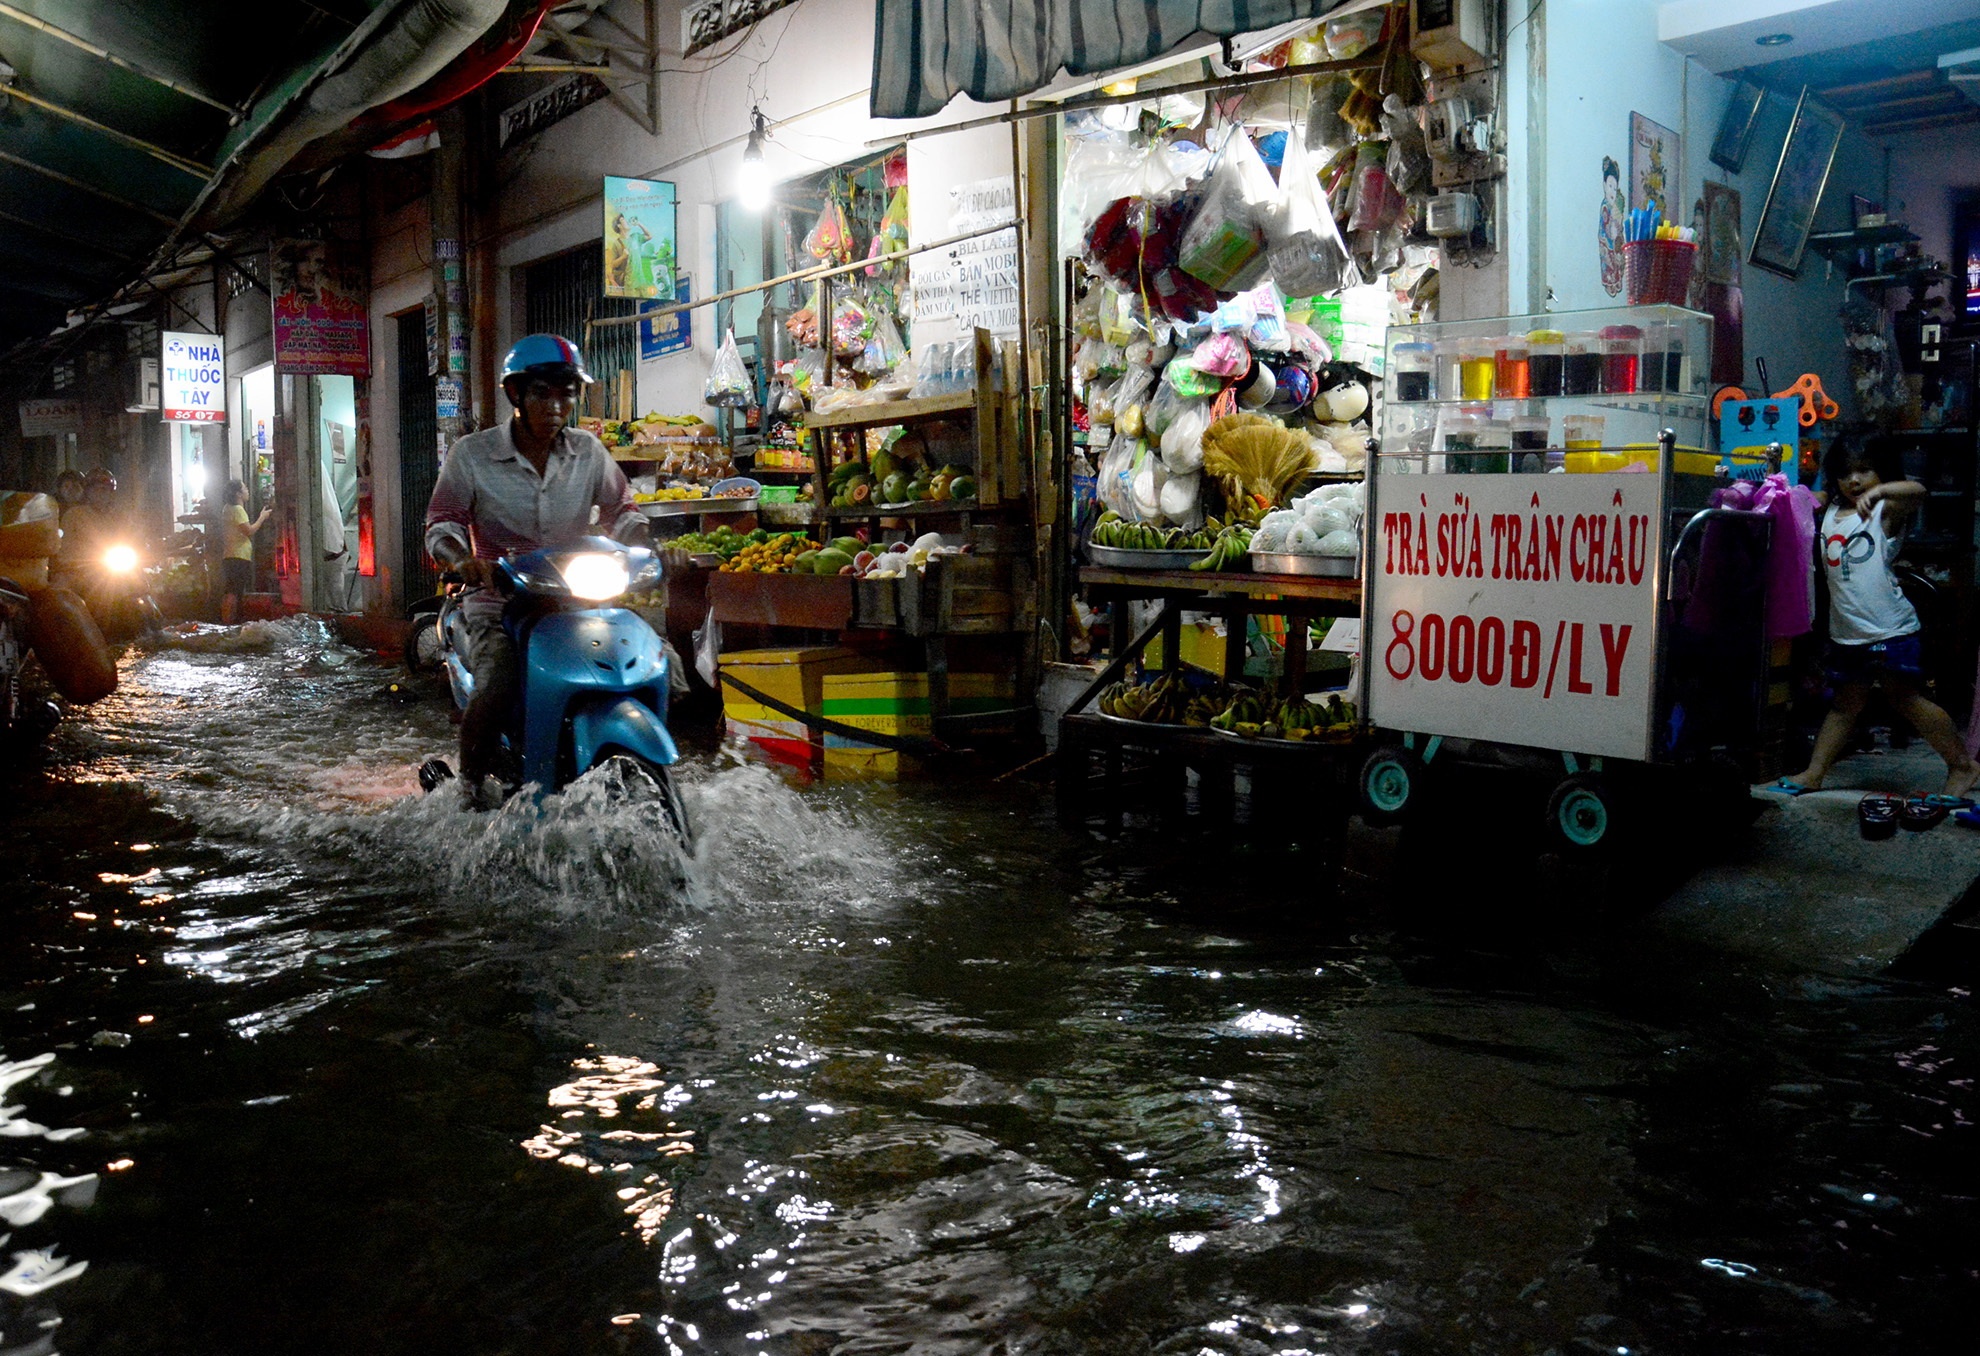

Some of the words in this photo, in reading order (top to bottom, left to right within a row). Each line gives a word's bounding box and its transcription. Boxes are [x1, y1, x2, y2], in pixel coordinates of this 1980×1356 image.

[957, 241, 979, 256] BIA
[960, 260, 982, 283] BÁN
[984, 252, 1017, 272] MOBI
[934, 268, 952, 283] GAS
[984, 270, 1018, 287] VINA
[932, 284, 955, 299] THAN
[960, 283, 982, 307] THẺ
[960, 309, 981, 331] CÀO
[997, 307, 1020, 327] MOB
[188, 344, 220, 362] NHÀ
[166, 364, 220, 384] THUỐC
[180, 387, 210, 405] TÂY
[1383, 492, 1430, 576] TRÀ
[1436, 492, 1483, 578] SỮA
[1491, 491, 1564, 582] TRÂN
[1569, 488, 1648, 586] CHÂU
[1385, 609, 1632, 699] 8000Đ/LY
